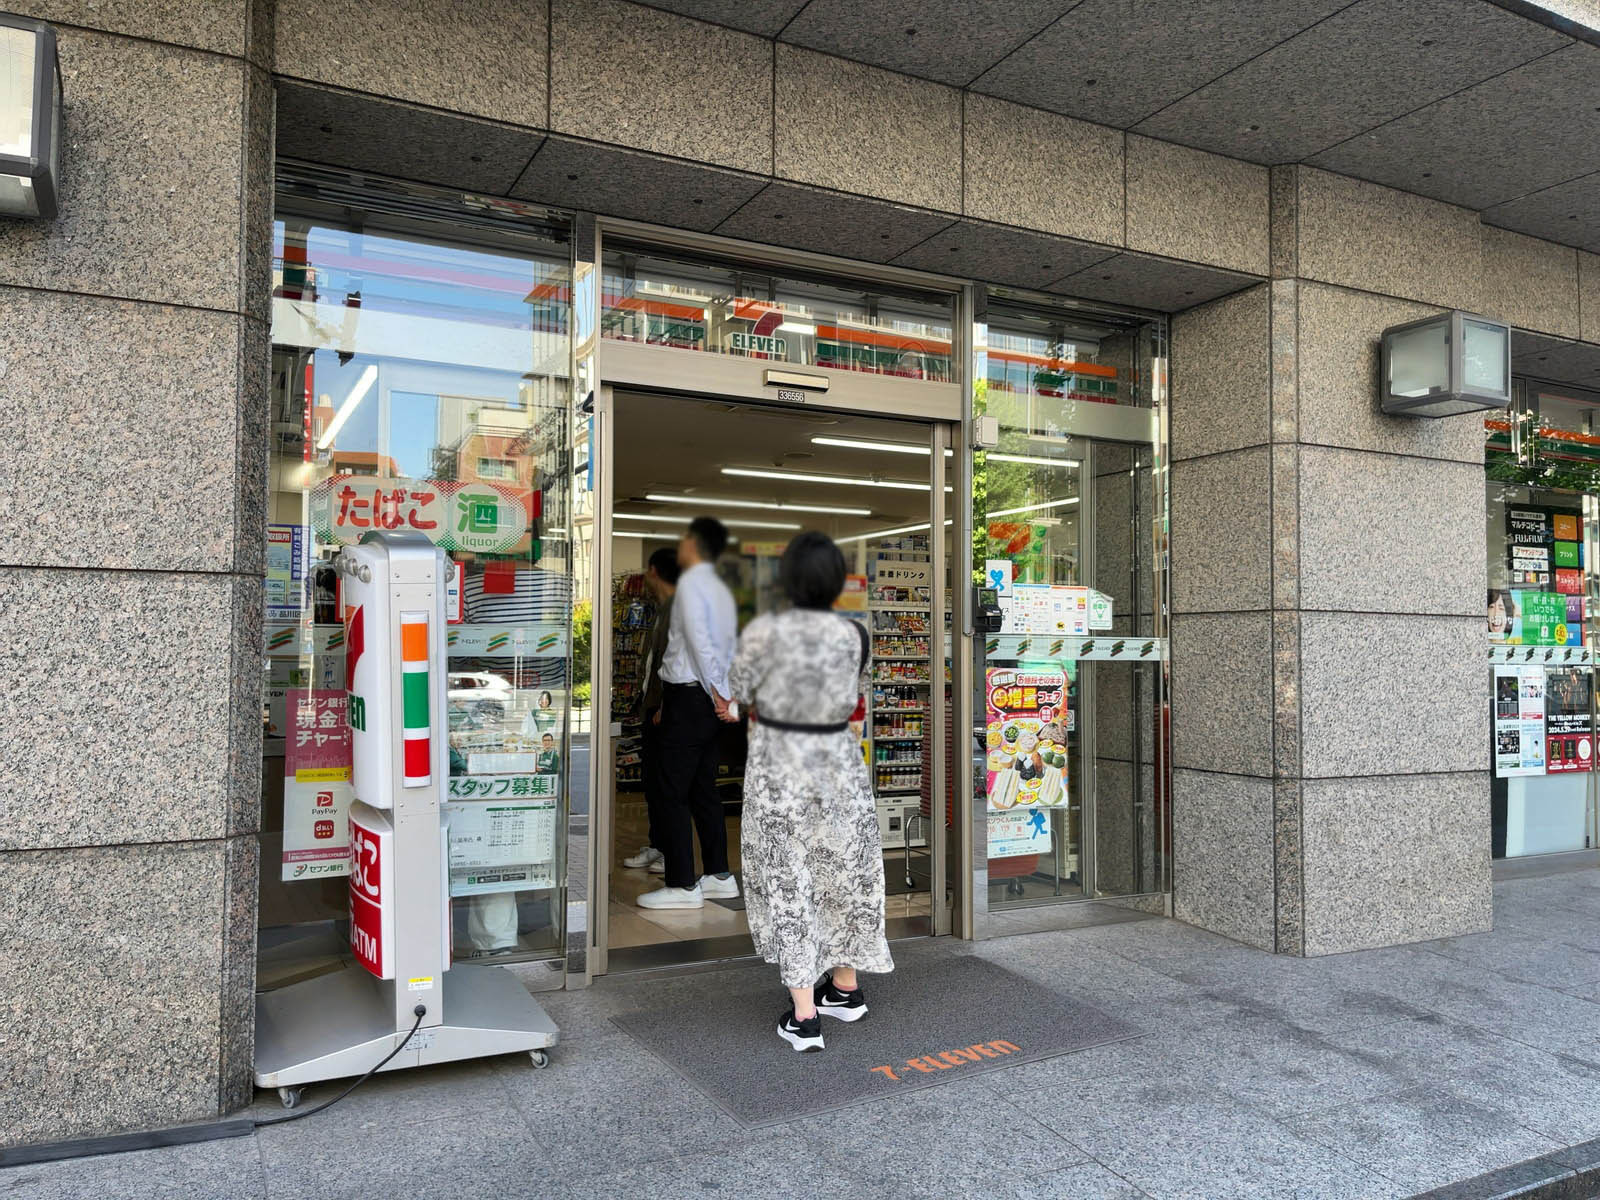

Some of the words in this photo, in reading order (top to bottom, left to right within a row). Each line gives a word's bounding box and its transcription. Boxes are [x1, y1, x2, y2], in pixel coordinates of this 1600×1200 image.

[337, 485, 437, 530] たばこ
[457, 492, 499, 534] 酒
[462, 536, 498, 547] liquor
[1514, 533, 1543, 543] FUJIFILM
[1533, 605, 1555, 614] いつでも
[310, 864, 344, 873] セブン銀行
